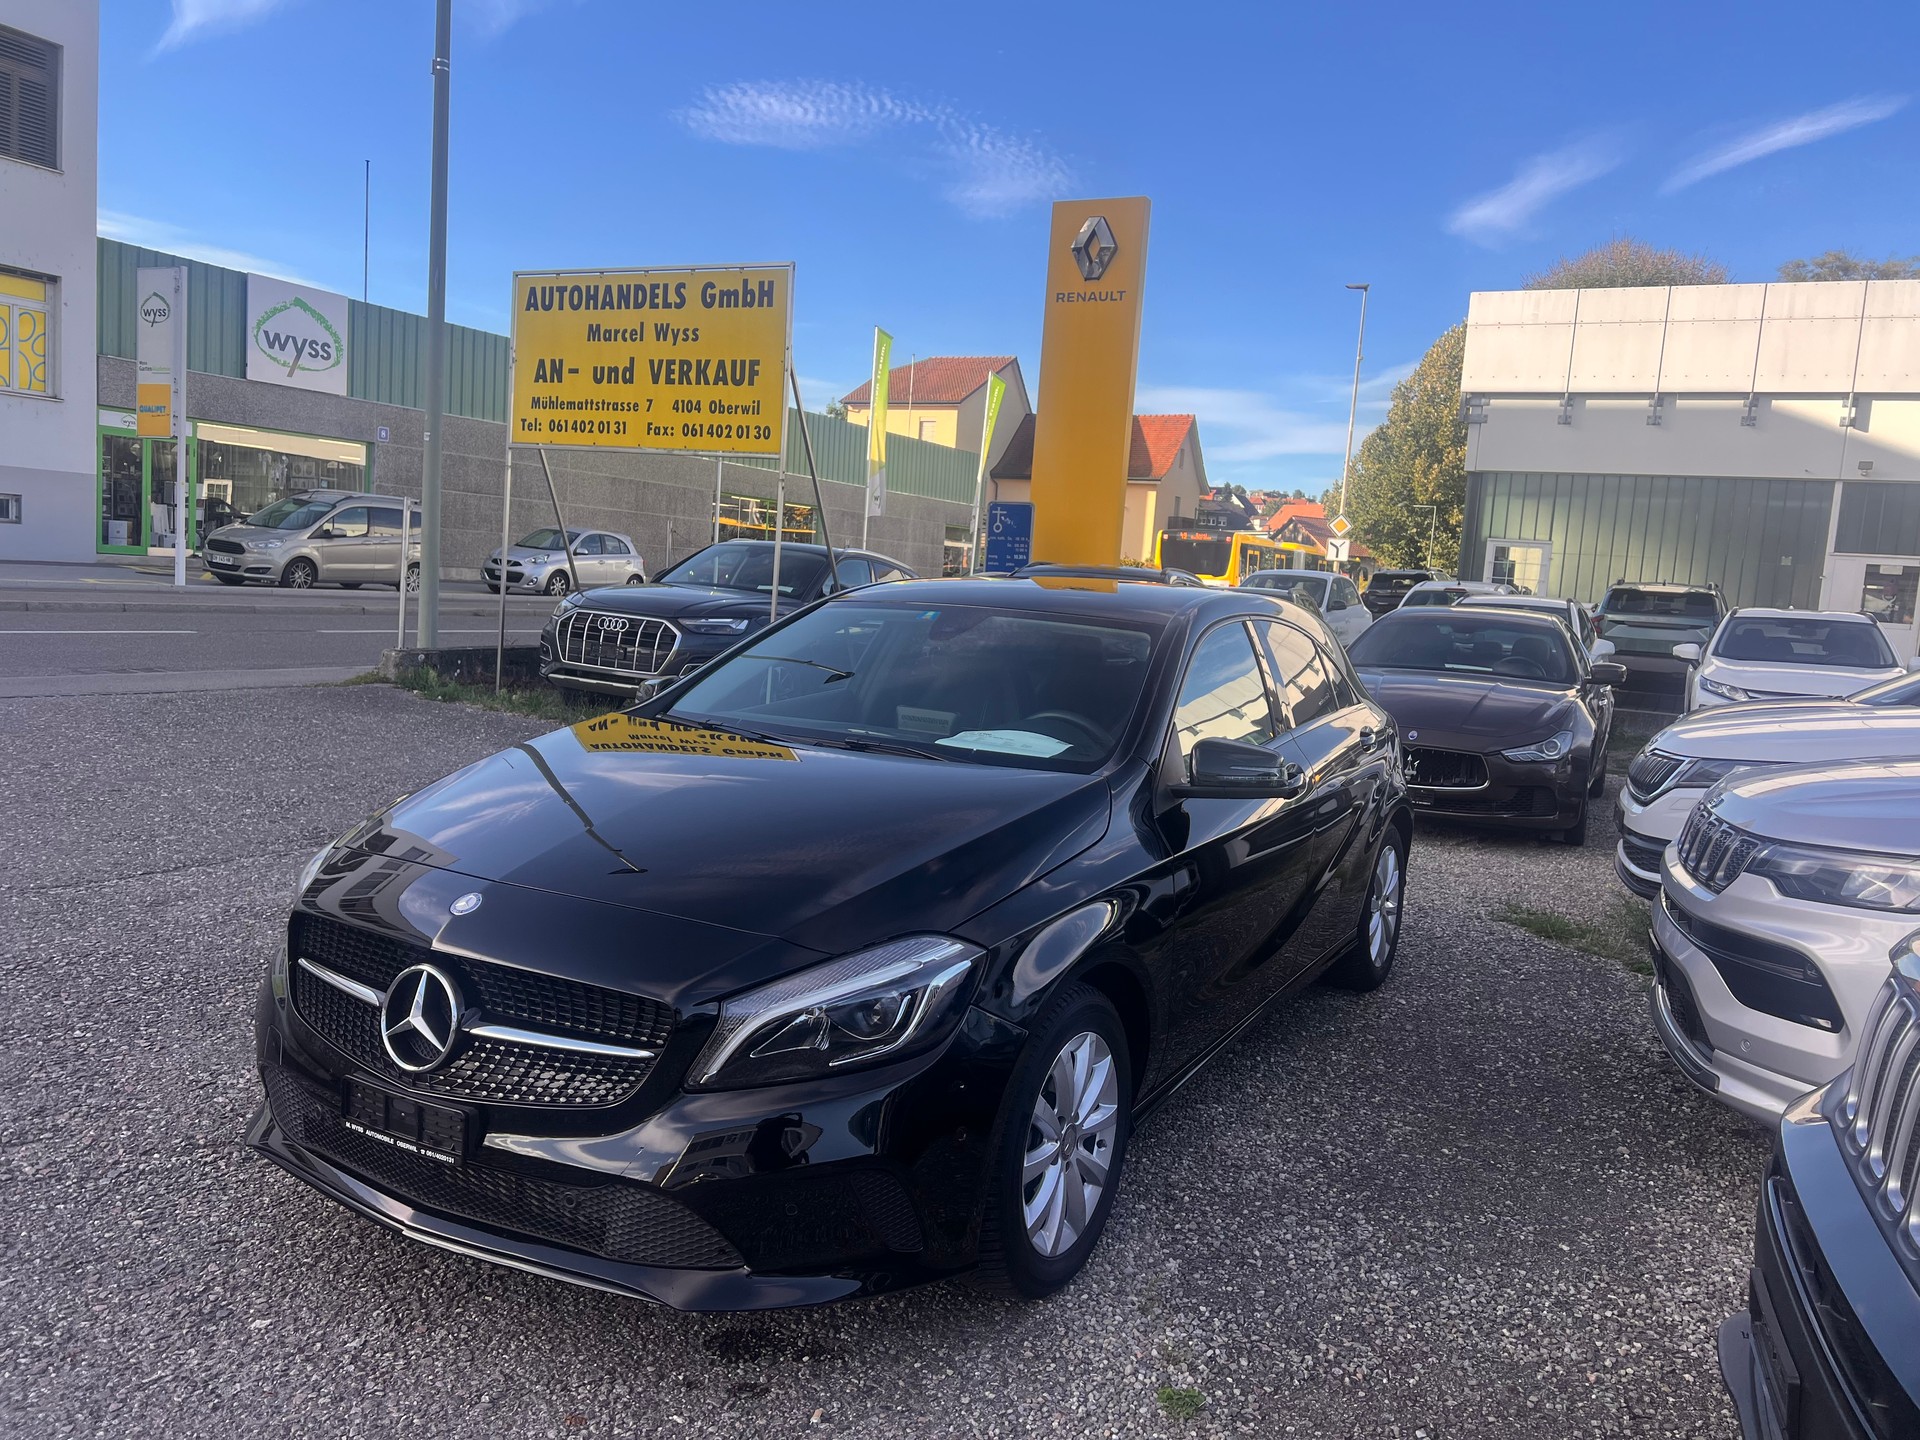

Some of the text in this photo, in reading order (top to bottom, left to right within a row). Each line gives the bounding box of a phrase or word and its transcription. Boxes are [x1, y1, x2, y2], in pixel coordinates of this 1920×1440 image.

[525, 279, 775, 311] AUTOHANDELS GmbH
[1055, 290, 1126, 303] RENAULT
[587, 321, 699, 346] Marcel Wyss
[262, 329, 332, 377] wyss
[533, 357, 761, 387] AN- und VERKAUF
[531, 396, 761, 415] Mühlemattstrasse 7 4104 Oberwil
[520, 417, 542, 432] Tel:
[646, 422, 675, 436] Fax:
